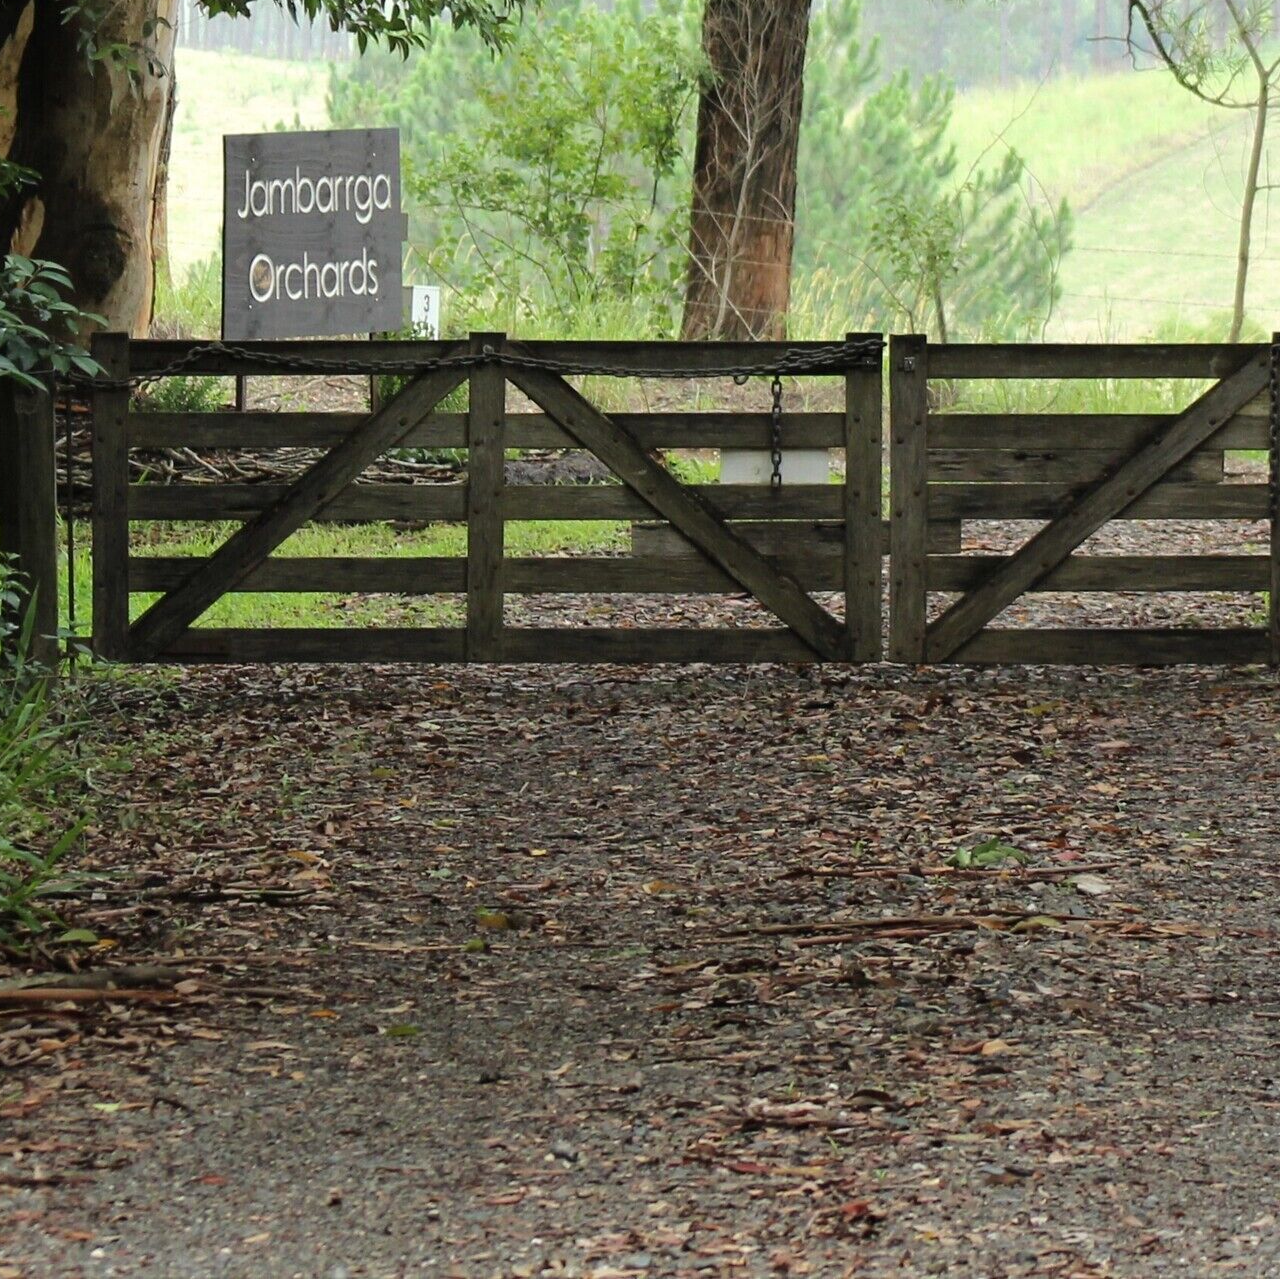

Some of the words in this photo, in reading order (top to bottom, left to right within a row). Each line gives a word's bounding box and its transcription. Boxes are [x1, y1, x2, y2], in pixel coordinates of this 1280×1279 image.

[237, 166, 392, 224] Jambarrga
[249, 248, 378, 302] Orchards
[423, 294, 430, 312] 3
